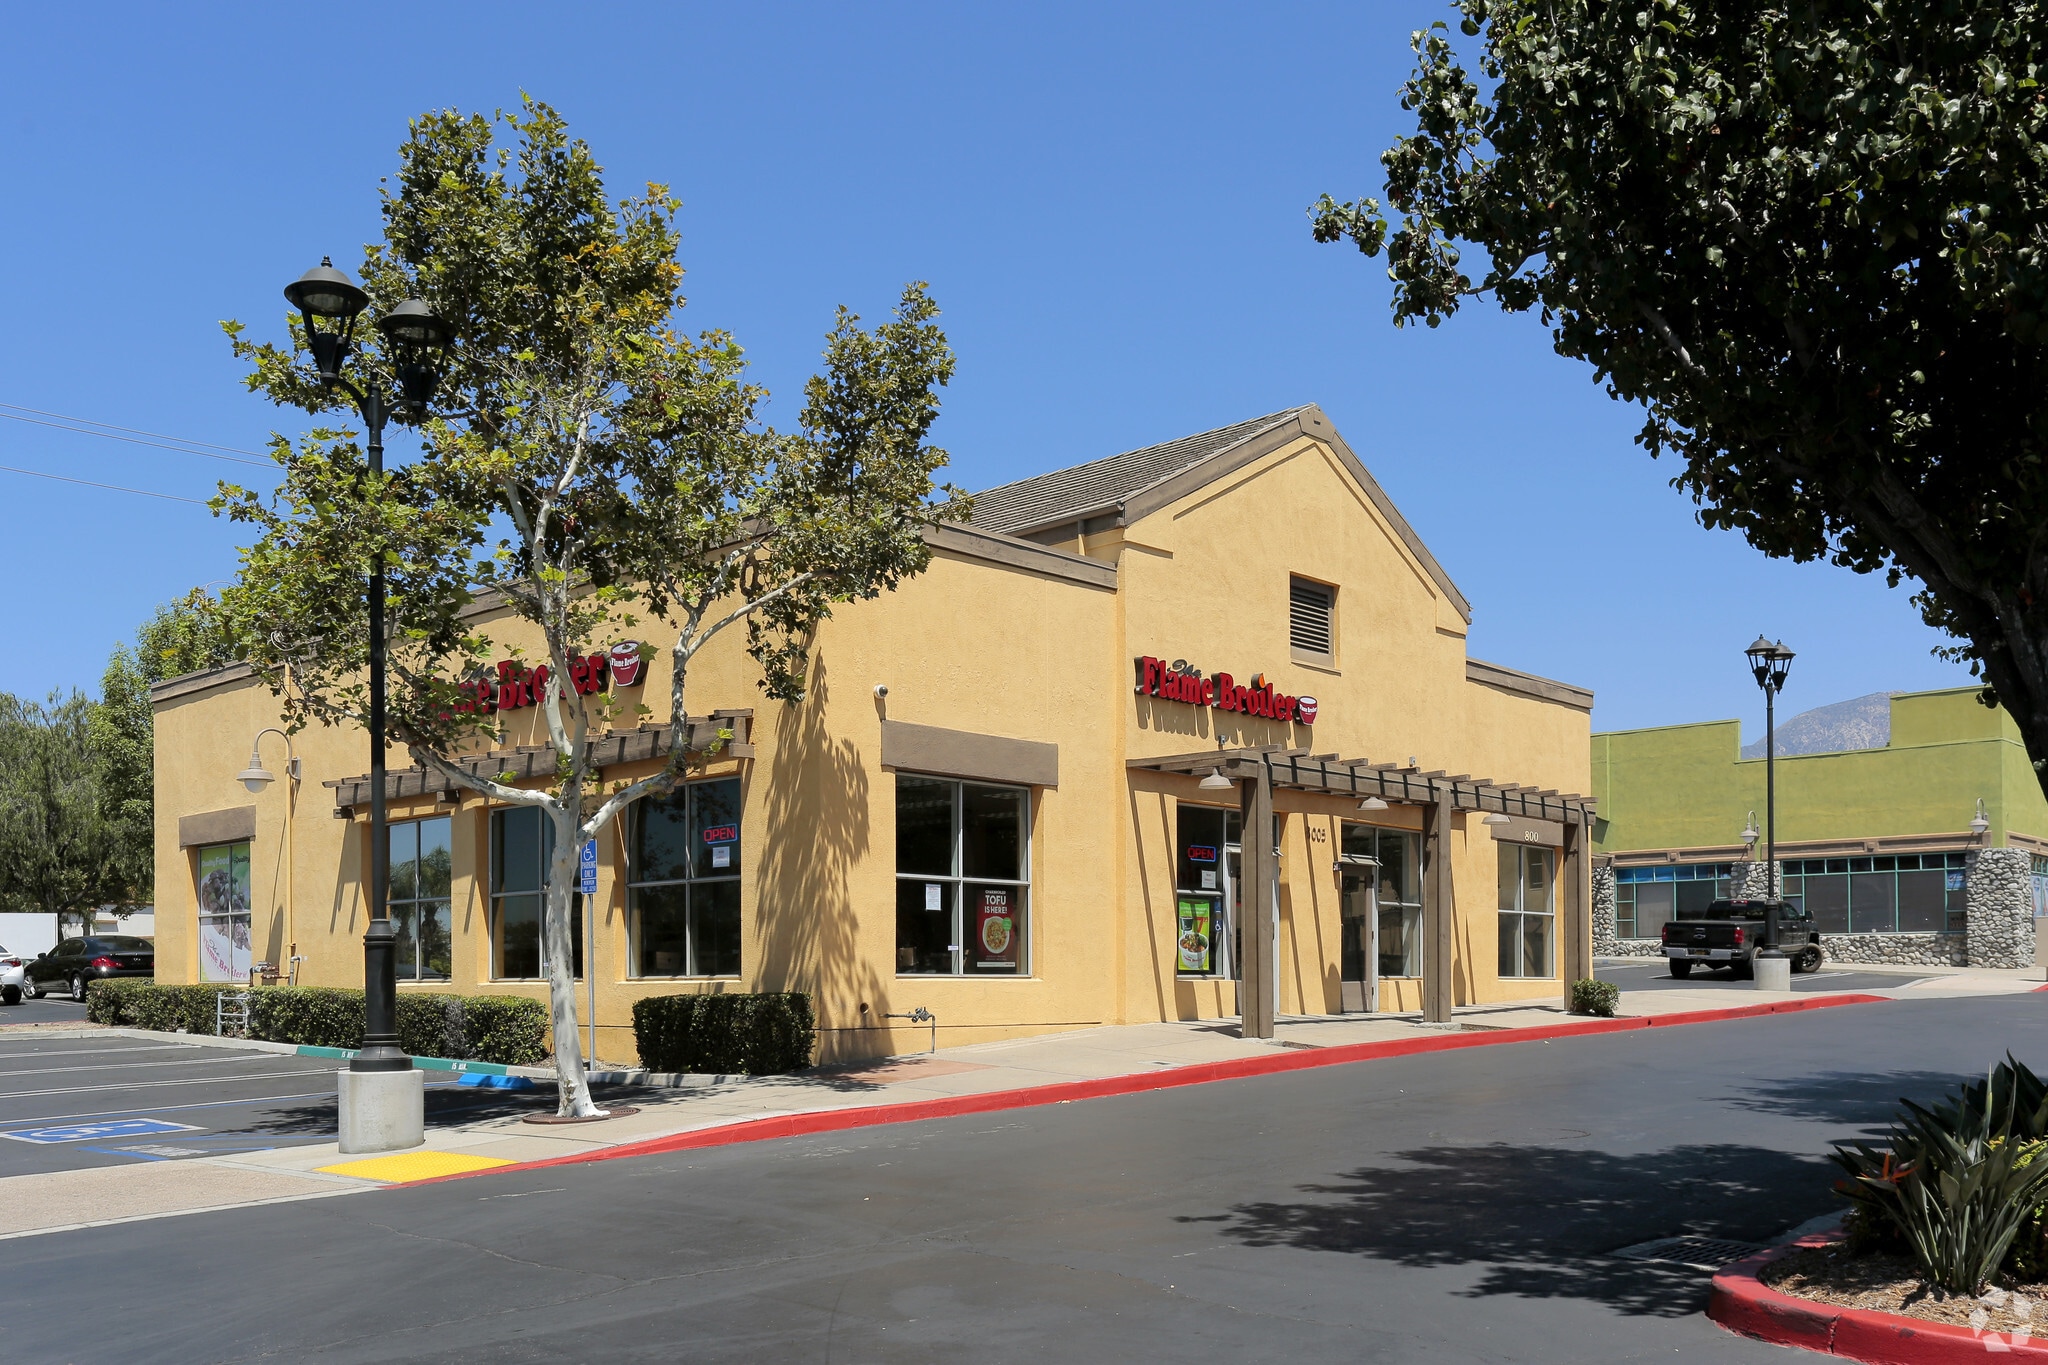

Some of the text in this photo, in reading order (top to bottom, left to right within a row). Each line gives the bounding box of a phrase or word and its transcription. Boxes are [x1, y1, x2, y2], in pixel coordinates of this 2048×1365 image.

[1140, 656, 1296, 721] Flame Broiler
[704, 827, 736, 842] OPEN
[1524, 830, 1539, 842] 800
[1188, 847, 1215, 859] OPEN
[985, 895, 1007, 906] TOFU
[984, 906, 1008, 914] IS HERE!
